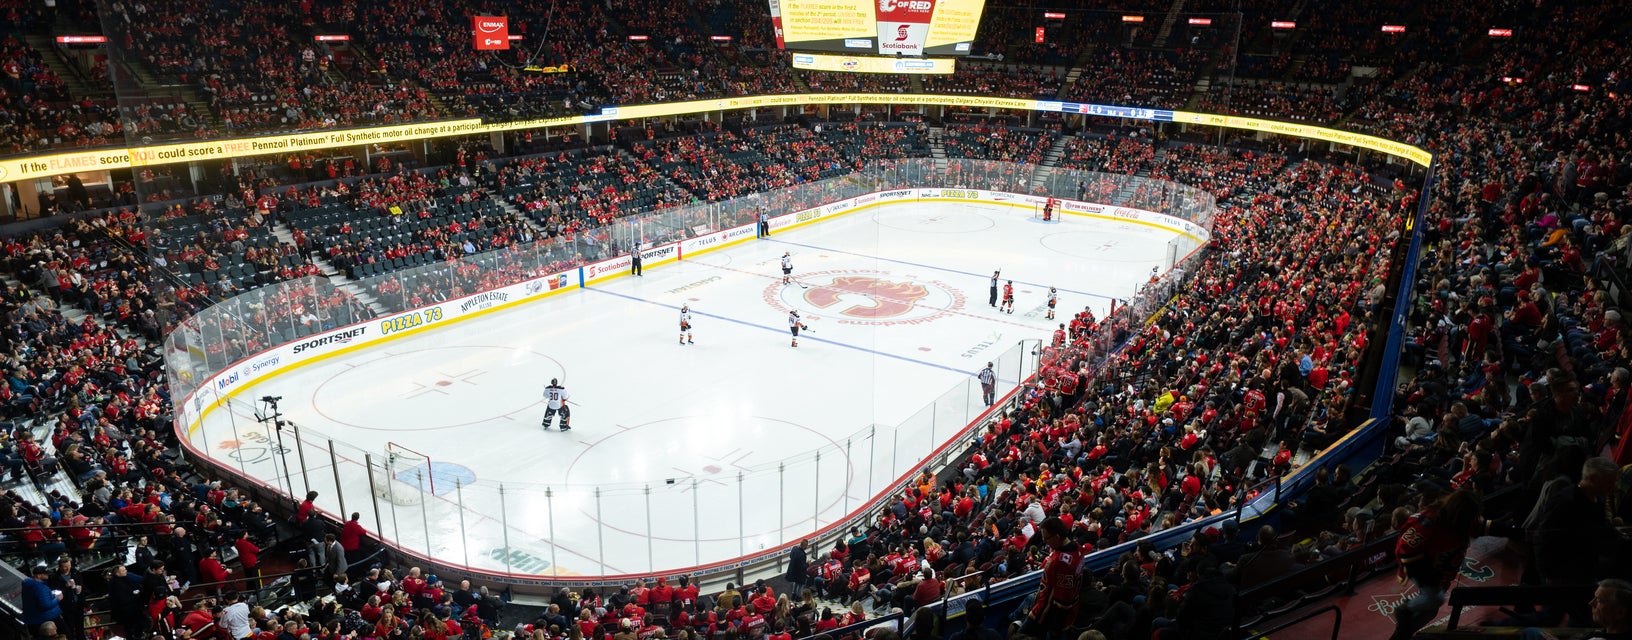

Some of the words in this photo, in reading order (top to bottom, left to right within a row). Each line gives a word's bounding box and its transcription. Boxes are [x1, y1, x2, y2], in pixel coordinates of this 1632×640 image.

[908, 1, 931, 10] RED
[21, 163, 29, 174] If
[31, 162, 48, 172] the
[50, 155, 98, 170] FLAMES
[100, 154, 130, 165] score
[132, 150, 156, 162] YOU
[158, 148, 186, 159] could
[188, 146, 216, 157] score
[216, 146, 222, 154] a
[224, 142, 250, 153] FREE
[252, 138, 288, 150] Pennzoil
[330, 134, 344, 143] Full
[346, 130, 381, 144] Synthetic
[382, 129, 403, 138] motor
[404, 128, 413, 136] oil
[414, 125, 438, 137] change
[880, 190, 912, 198] SPORTSNET
[941, 190, 965, 198] PIZZA
[967, 190, 978, 198] 73
[1164, 217, 1181, 226] TELUS
[736, 227, 753, 237] CANADA
[698, 236, 716, 247] TELUS
[641, 246, 674, 260] PORTSNET
[598, 259, 631, 274] Scotiabank
[461, 292, 490, 313] APPLETON
[490, 292, 508, 303] ESTATE
[381, 311, 422, 334] PIZZA
[425, 307, 442, 324] 73
[293, 327, 366, 354] SPORTSNET
[218, 372, 239, 390] Mobil
[252, 356, 280, 372] Synergy
[549, 392, 558, 400] 30
[1246, 398, 1256, 409] 3
